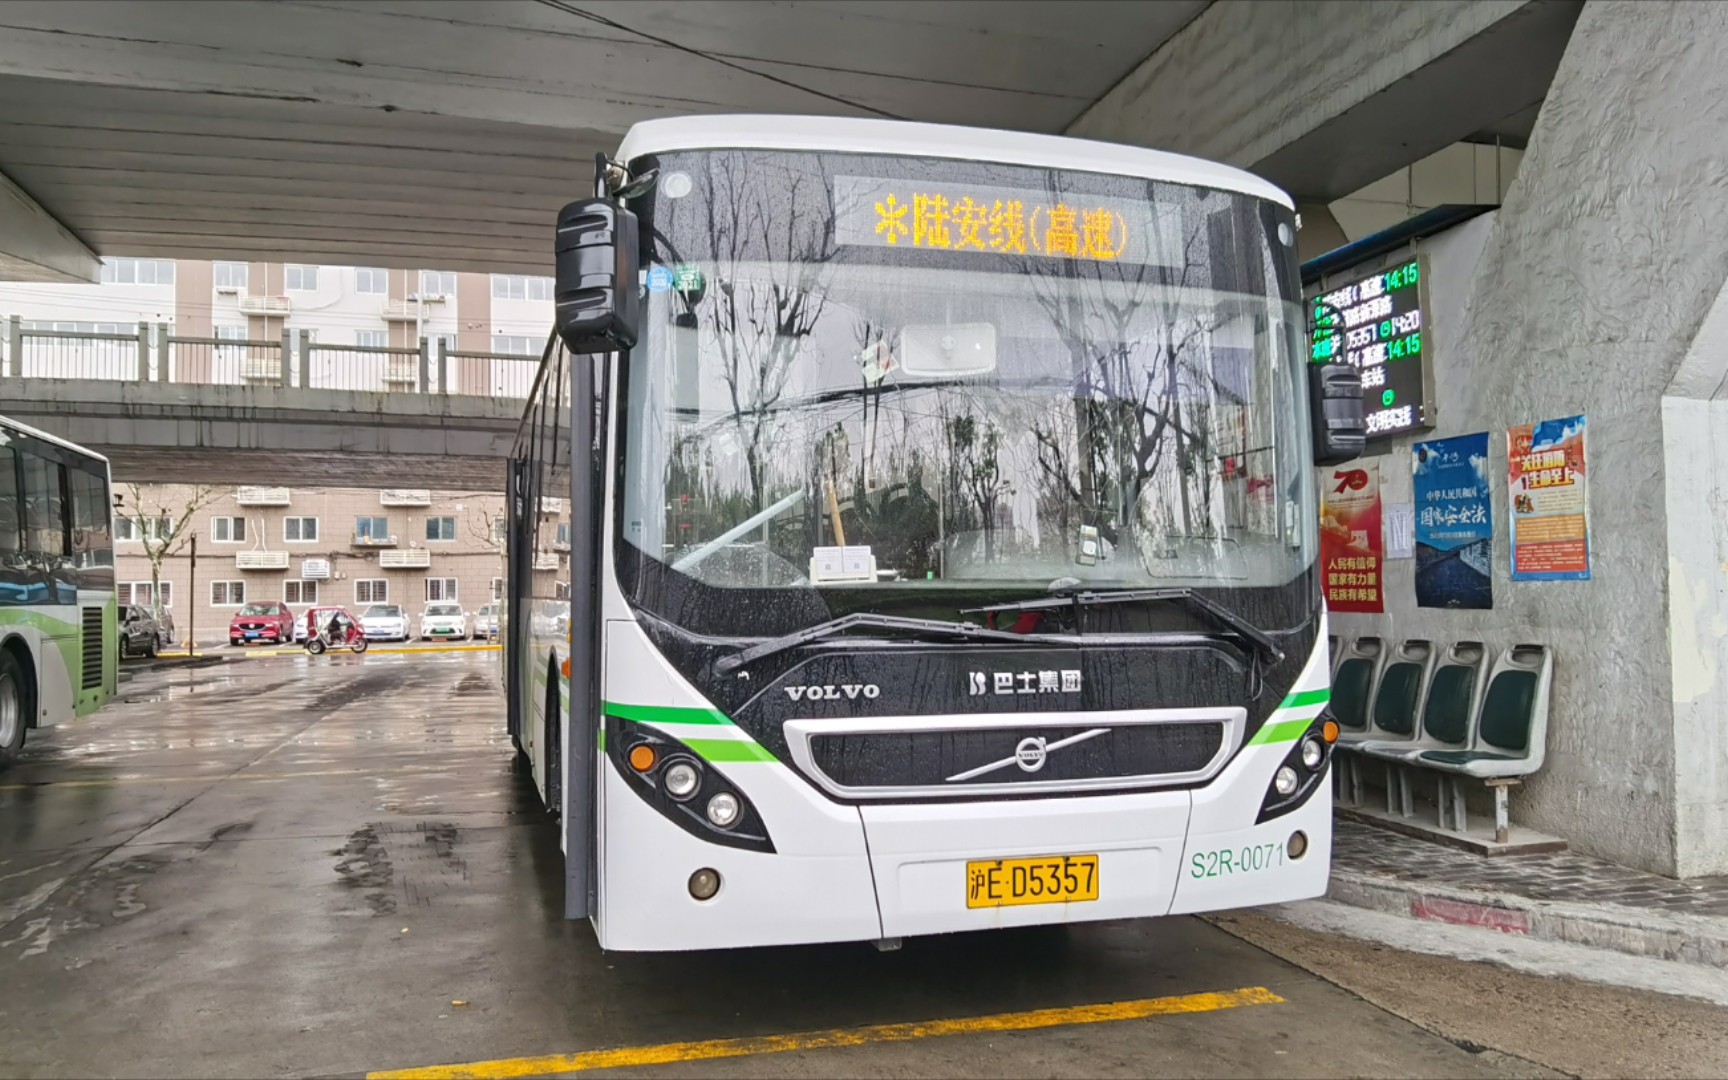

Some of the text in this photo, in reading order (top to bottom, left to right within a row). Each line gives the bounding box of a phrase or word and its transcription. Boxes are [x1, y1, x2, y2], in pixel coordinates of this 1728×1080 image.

[1385, 262, 1419, 291] 14:15
[1387, 333, 1420, 360] 14:15
[1420, 502, 1487, 527] 国家安全法
[1328, 557, 1377, 570] 人民有信仰
[1329, 588, 1377, 602] 民族有希望
[784, 684, 880, 701] VOLVO
[994, 669, 1081, 695] 巴士集团
[1191, 842, 1284, 879] S2R-0071
